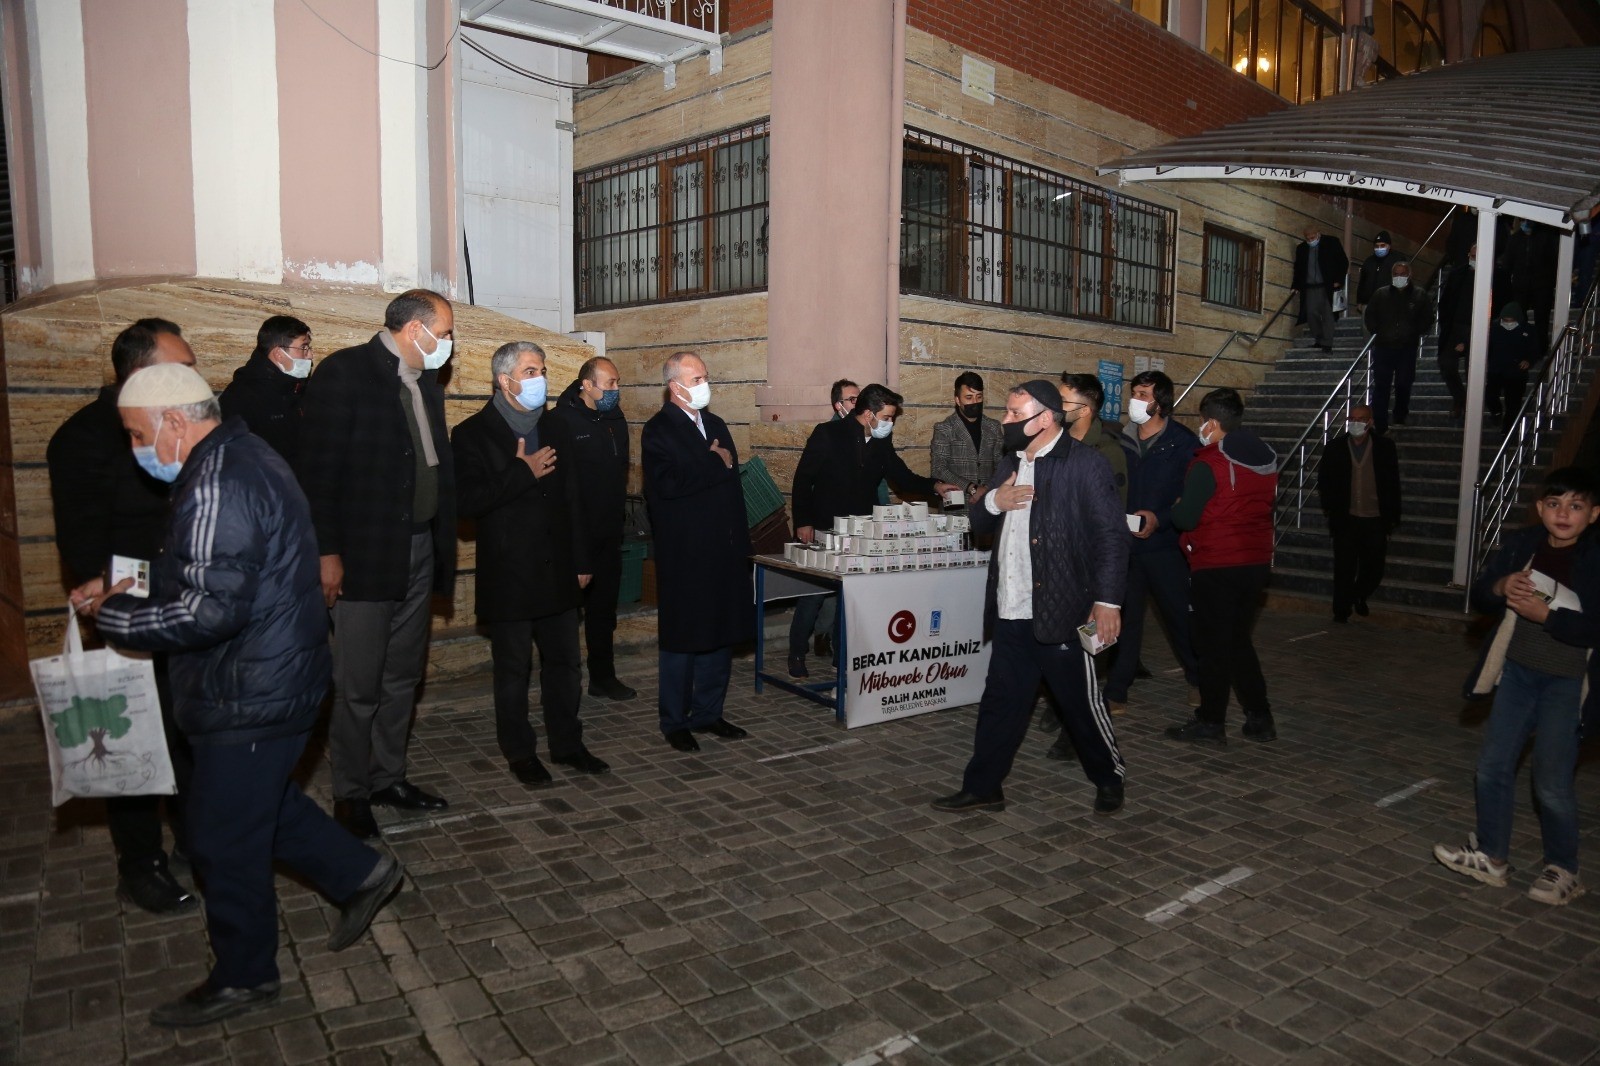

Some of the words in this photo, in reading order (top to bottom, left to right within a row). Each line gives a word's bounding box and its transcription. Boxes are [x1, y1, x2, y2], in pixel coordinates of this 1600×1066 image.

[1249, 166, 1307, 179] YUKAI
[852, 651, 896, 671] BERAT
[899, 639, 981, 663] KANDİLİNİZ
[859, 667, 924, 695] Mübarek
[925, 662, 968, 684] Olsun
[911, 686, 946, 701] AKMAN
